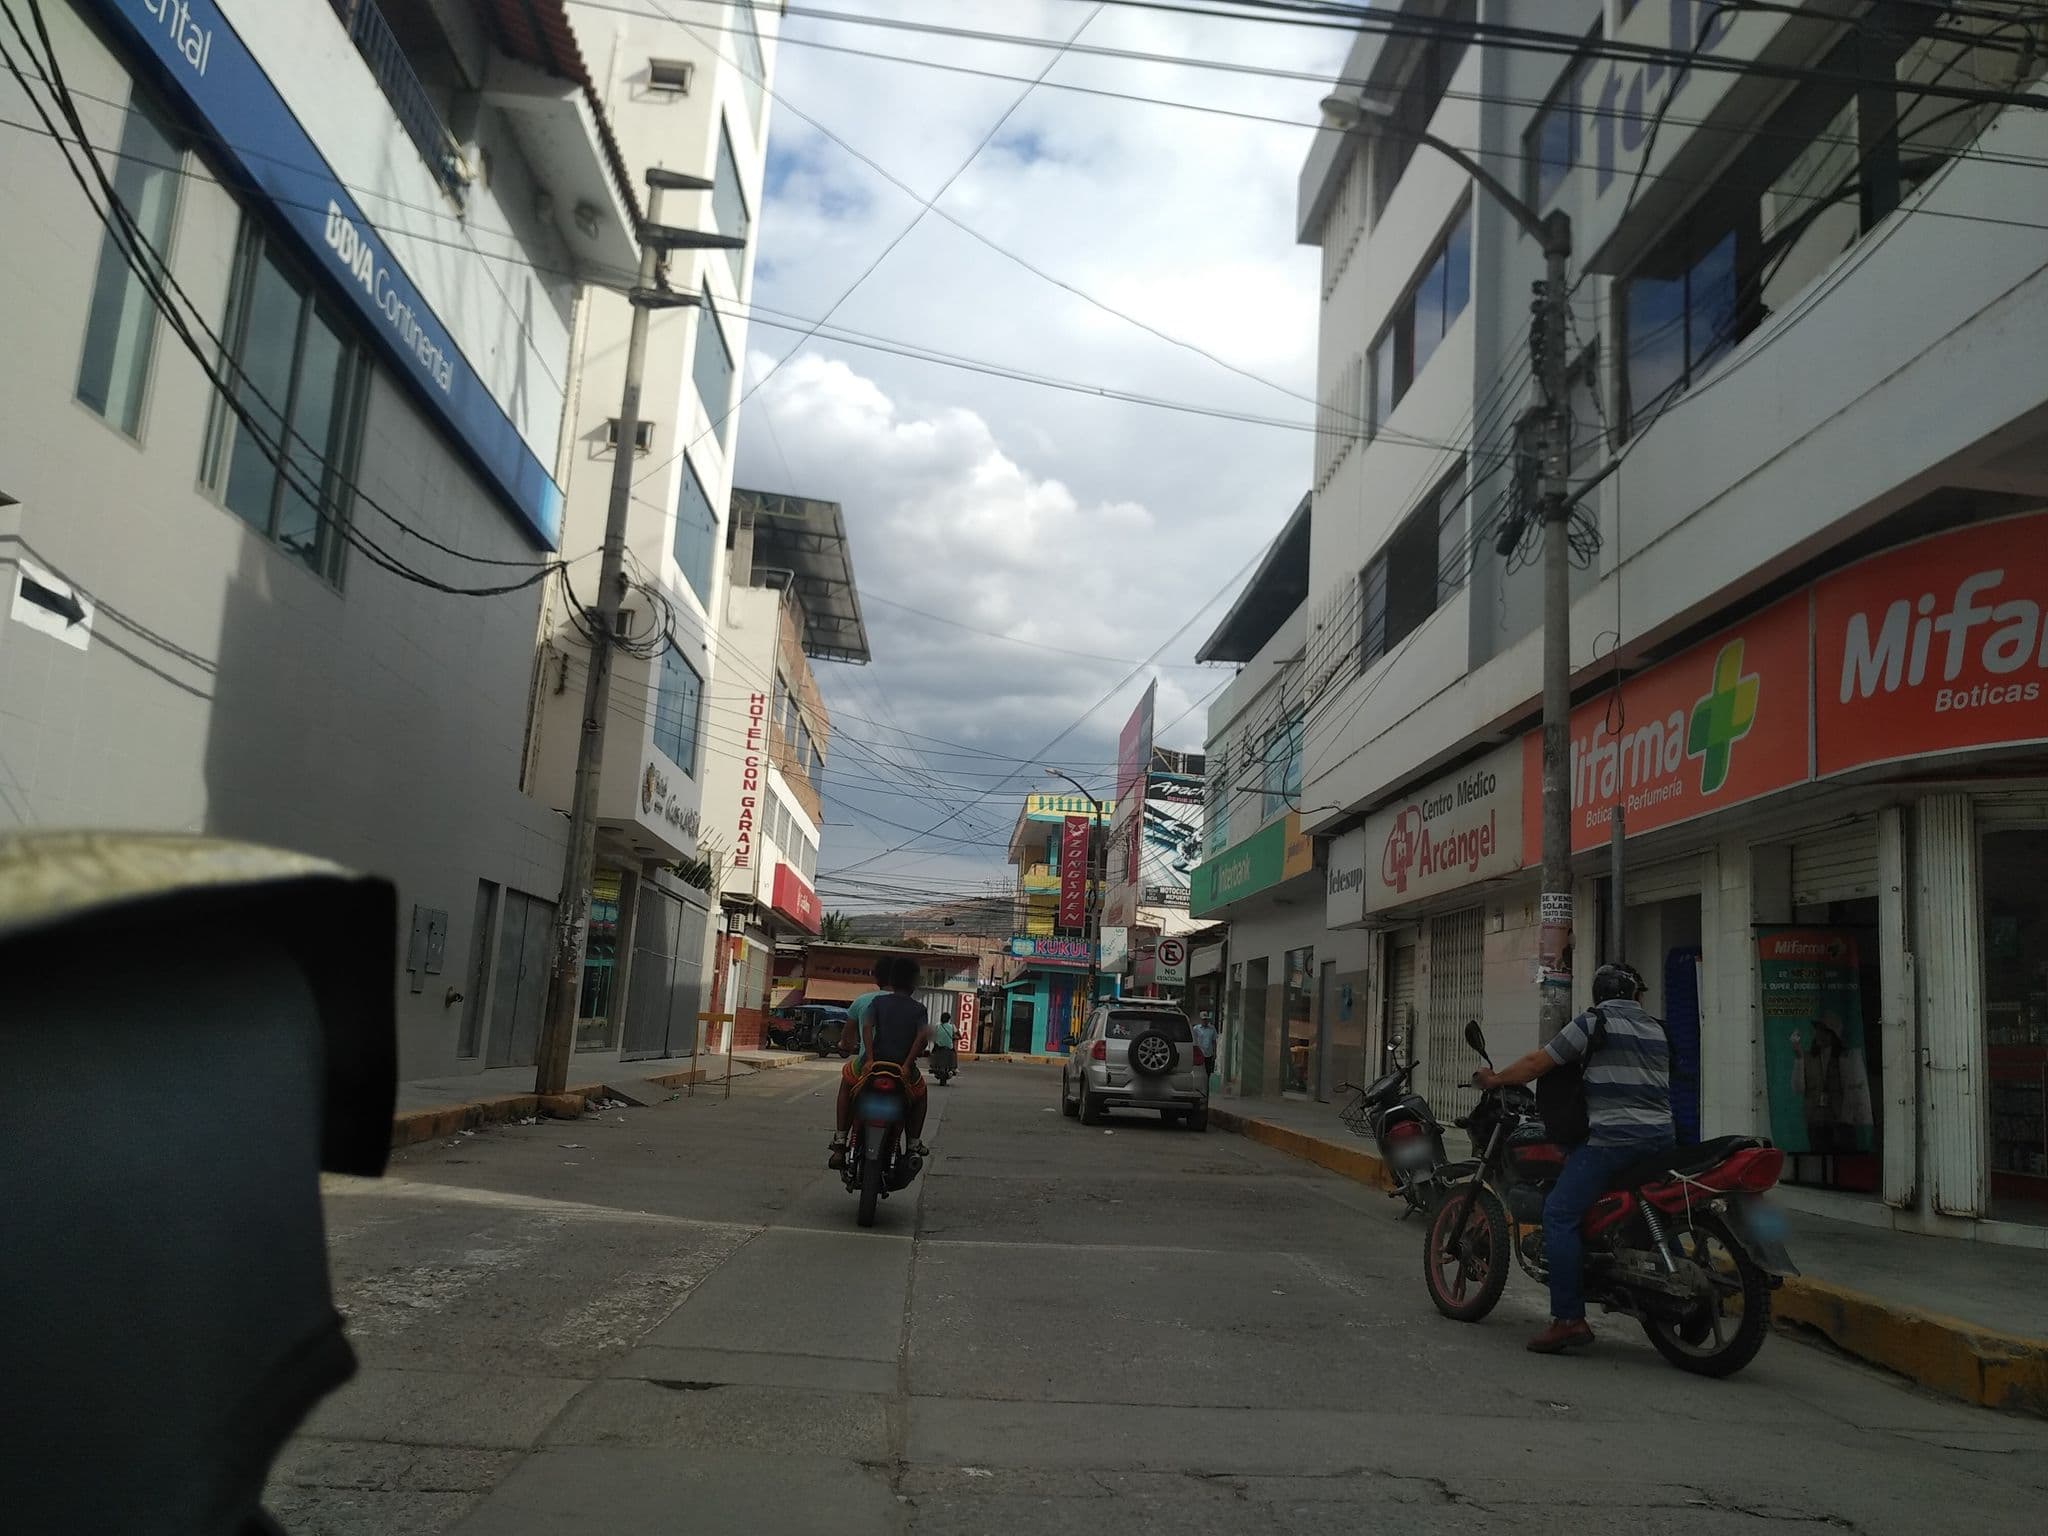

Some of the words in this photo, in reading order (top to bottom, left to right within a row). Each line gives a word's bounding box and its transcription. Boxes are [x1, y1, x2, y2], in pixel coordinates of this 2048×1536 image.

[144, 0, 212, 77] ntal
[325, 199, 373, 295] BBVA
[375, 268, 454, 395] Continental
[1840, 568, 2048, 704] Mifa
[746, 693, 765, 751] HOTEL
[1935, 682, 2040, 712] Boticas
[742, 757, 759, 791] CON
[1422, 793, 1453, 823] Centro
[1457, 771, 1496, 807] Médico
[1627, 777, 1683, 813] Perfumería
[734, 797, 756, 867] GARAJE
[1419, 808, 1496, 877] Arcángel
[1064, 840, 1082, 920] ZONGSHEN
[1328, 866, 1363, 895] telesup
[959, 994, 973, 1050] COPIAS
